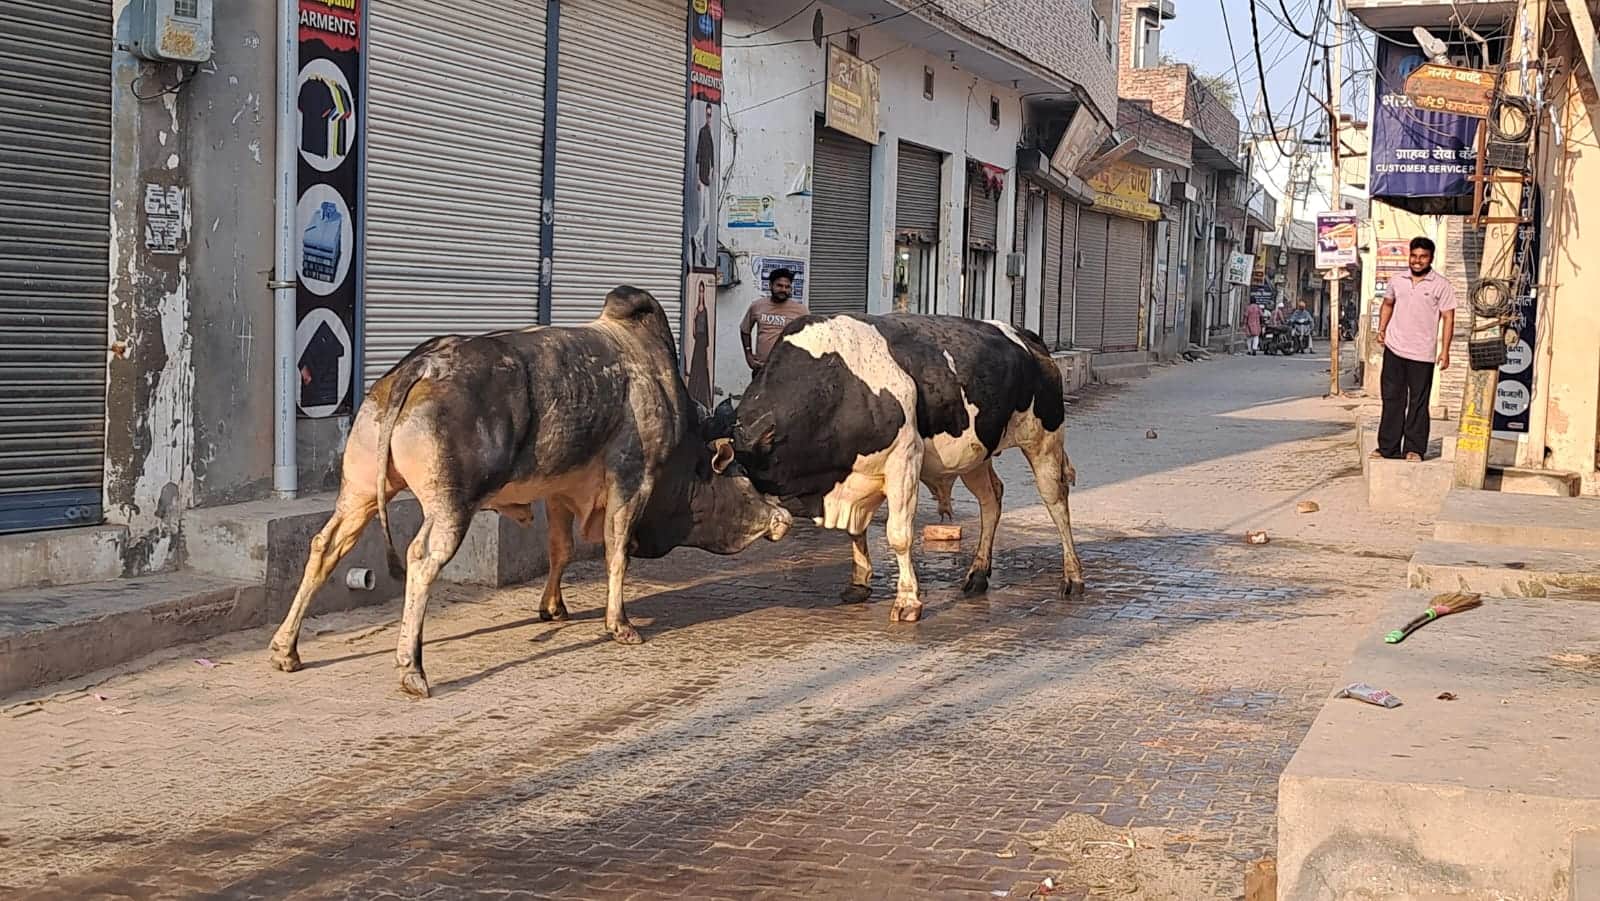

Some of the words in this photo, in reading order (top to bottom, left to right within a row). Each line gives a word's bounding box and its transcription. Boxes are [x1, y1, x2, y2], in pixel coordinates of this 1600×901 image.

[300, 9, 356, 36] ARMENTS
[1396, 148, 1430, 160] ग्राहक
[1432, 145, 1457, 160] सेवा
[1375, 164, 1426, 173] CUSTOMER
[1428, 164, 1467, 173] SERVICE
[761, 313, 786, 324] BOSS
